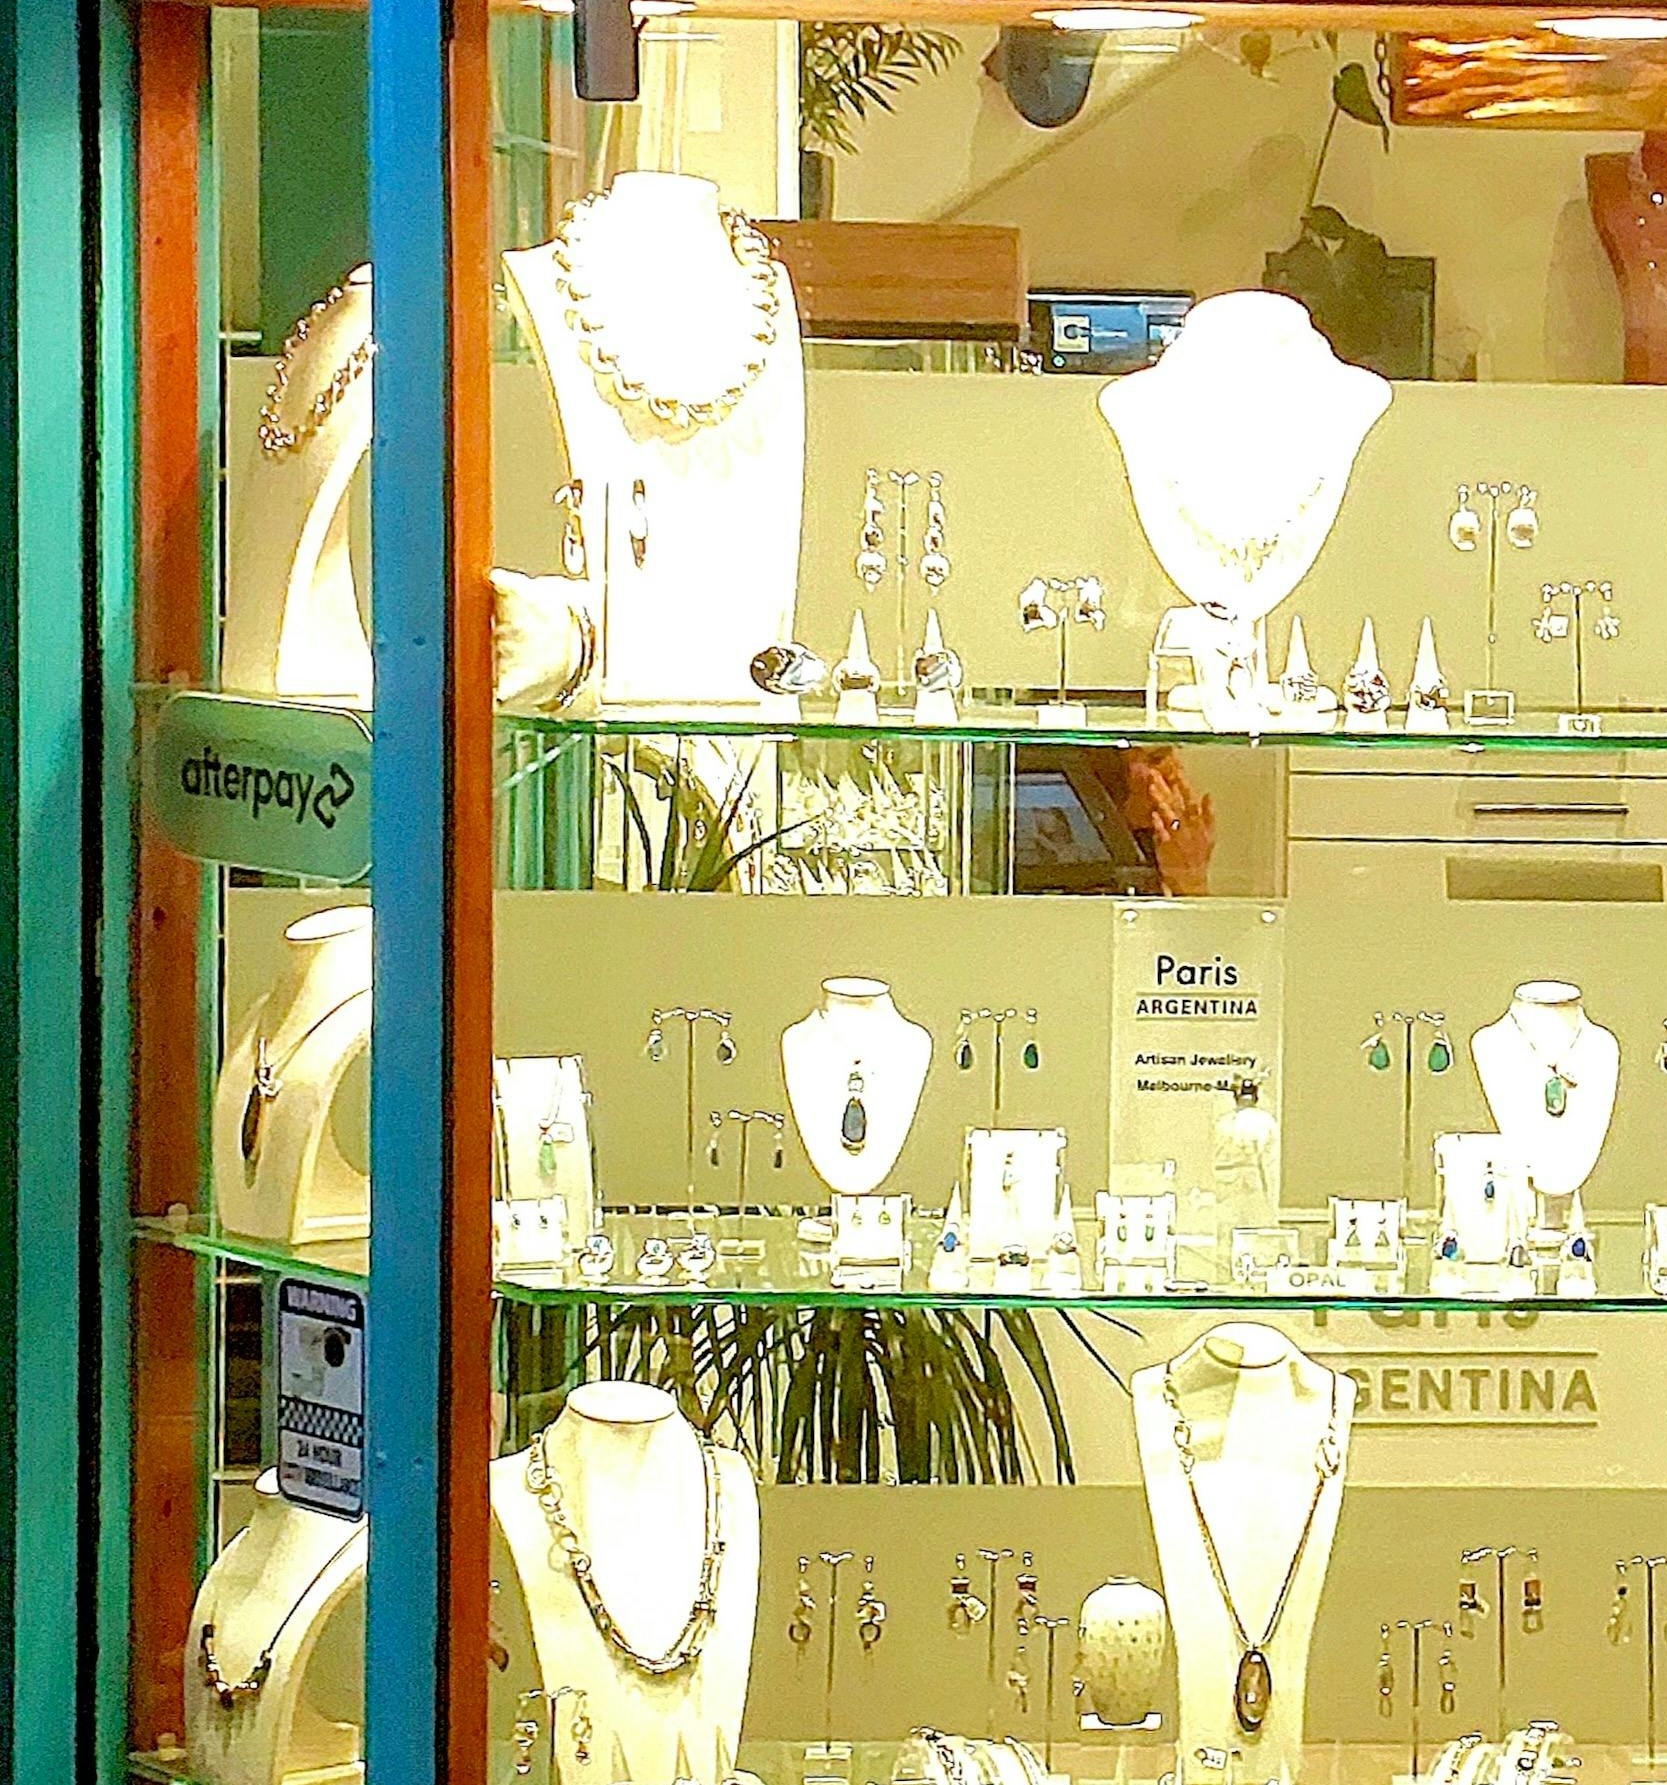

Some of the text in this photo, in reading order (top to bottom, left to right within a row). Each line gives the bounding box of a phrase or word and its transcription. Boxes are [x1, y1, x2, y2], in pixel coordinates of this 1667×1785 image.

[181, 745, 314, 824] afterpay
[1156, 954, 1238, 986] Paris
[1136, 999, 1258, 1015] ARGENTINA
[1135, 1054, 1186, 1066] Artisan
[1137, 1079, 1211, 1092] Melbourne
[1288, 1272, 1346, 1287] OPAL
[1344, 1368, 1598, 1411] GENTINA
